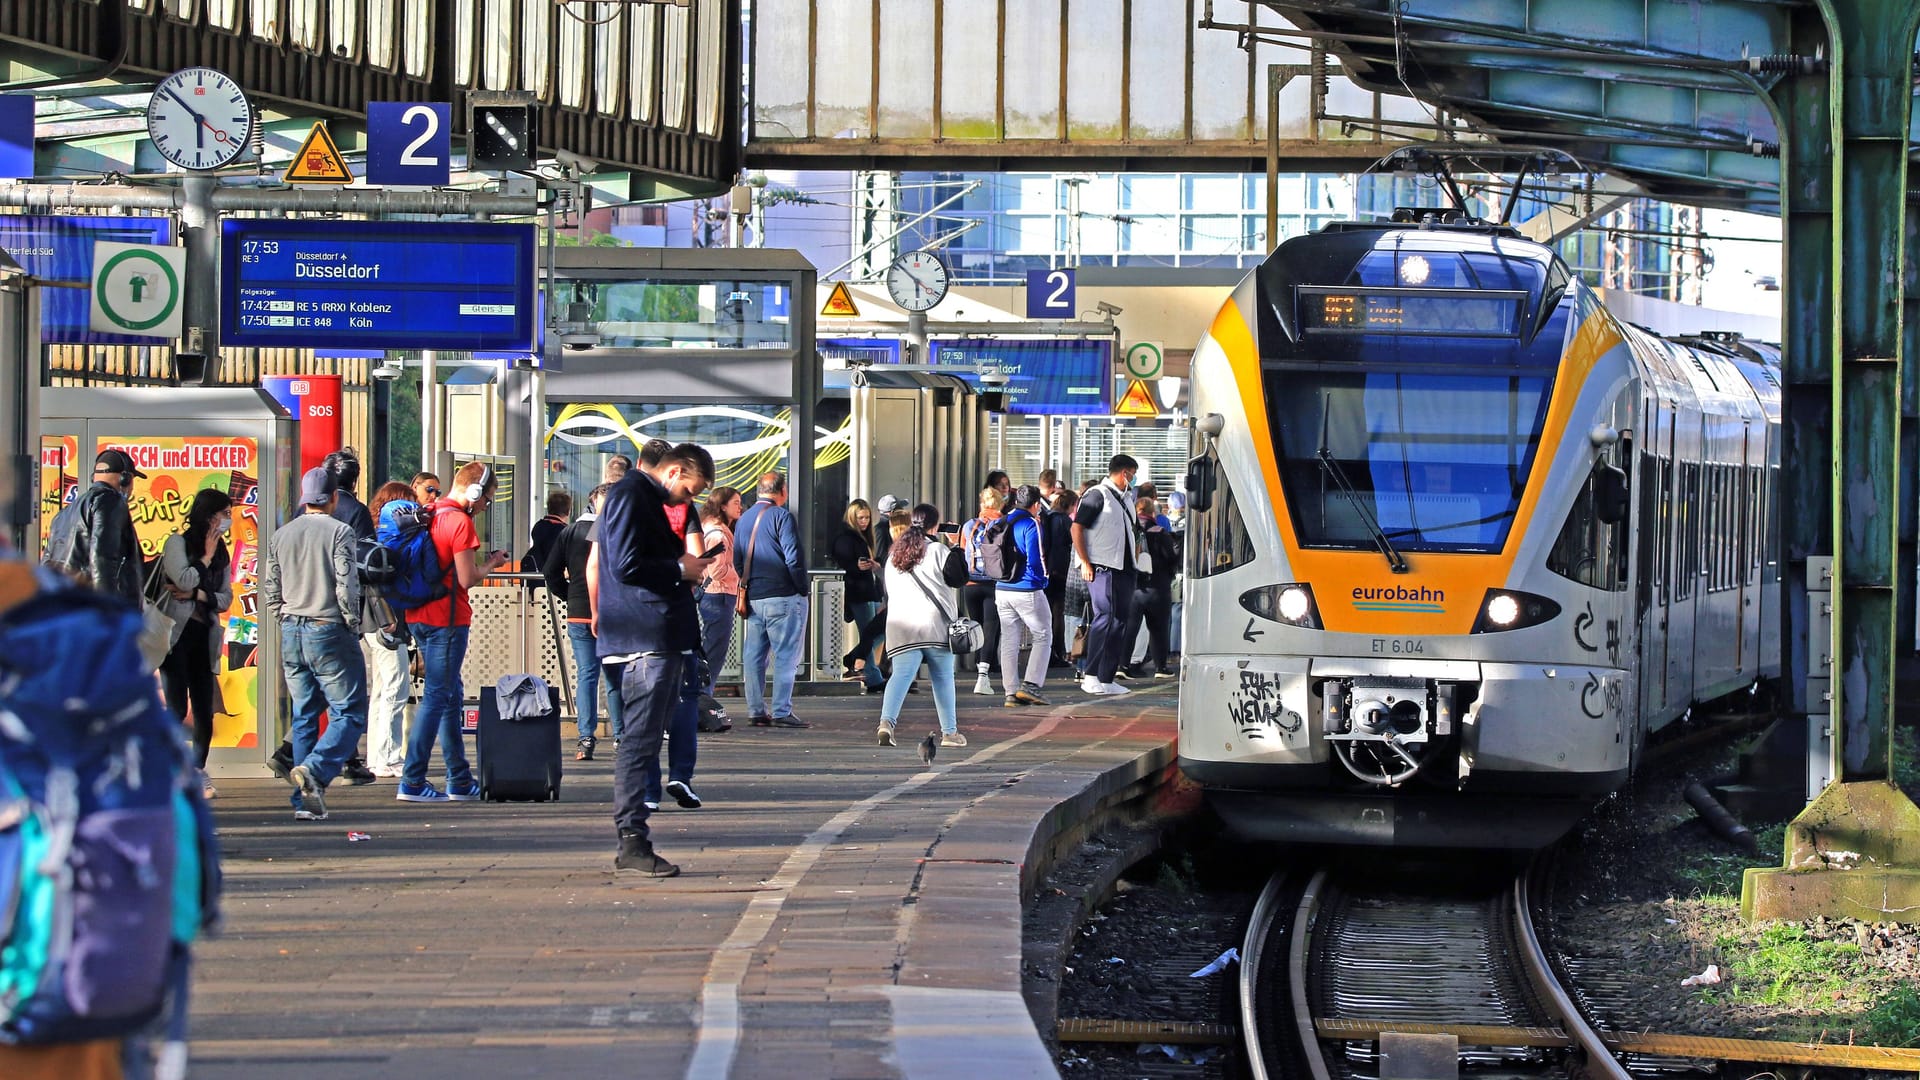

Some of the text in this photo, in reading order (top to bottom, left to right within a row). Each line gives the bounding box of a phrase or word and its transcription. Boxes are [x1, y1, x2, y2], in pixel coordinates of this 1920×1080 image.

[400, 105, 439, 166] 2
[4, 247, 54, 256] sterfeld Süd
[243, 241, 279, 254] 17:53
[242, 254, 260, 263] RE 3
[296, 252, 338, 260] Düsseldorf
[295, 262, 380, 279] Düsseldorf
[1046, 272, 1069, 308] 2
[240, 300, 270, 311] 17:42
[296, 303, 308, 312] RE
[312, 303, 318, 312] 5
[322, 302, 346, 312] (RRX)
[350, 302, 392, 312] Koblenz
[240, 315, 270, 326] 17:50
[296, 318, 311, 326] ICE
[314, 318, 332, 326] 848
[350, 317, 372, 328] Köln
[309, 405, 333, 416] SOS
[163, 446, 190, 468] und
[194, 446, 247, 468] LECKER
[1352, 585, 1444, 602] eurobahn
[1372, 639, 1424, 654] ET 6.04
